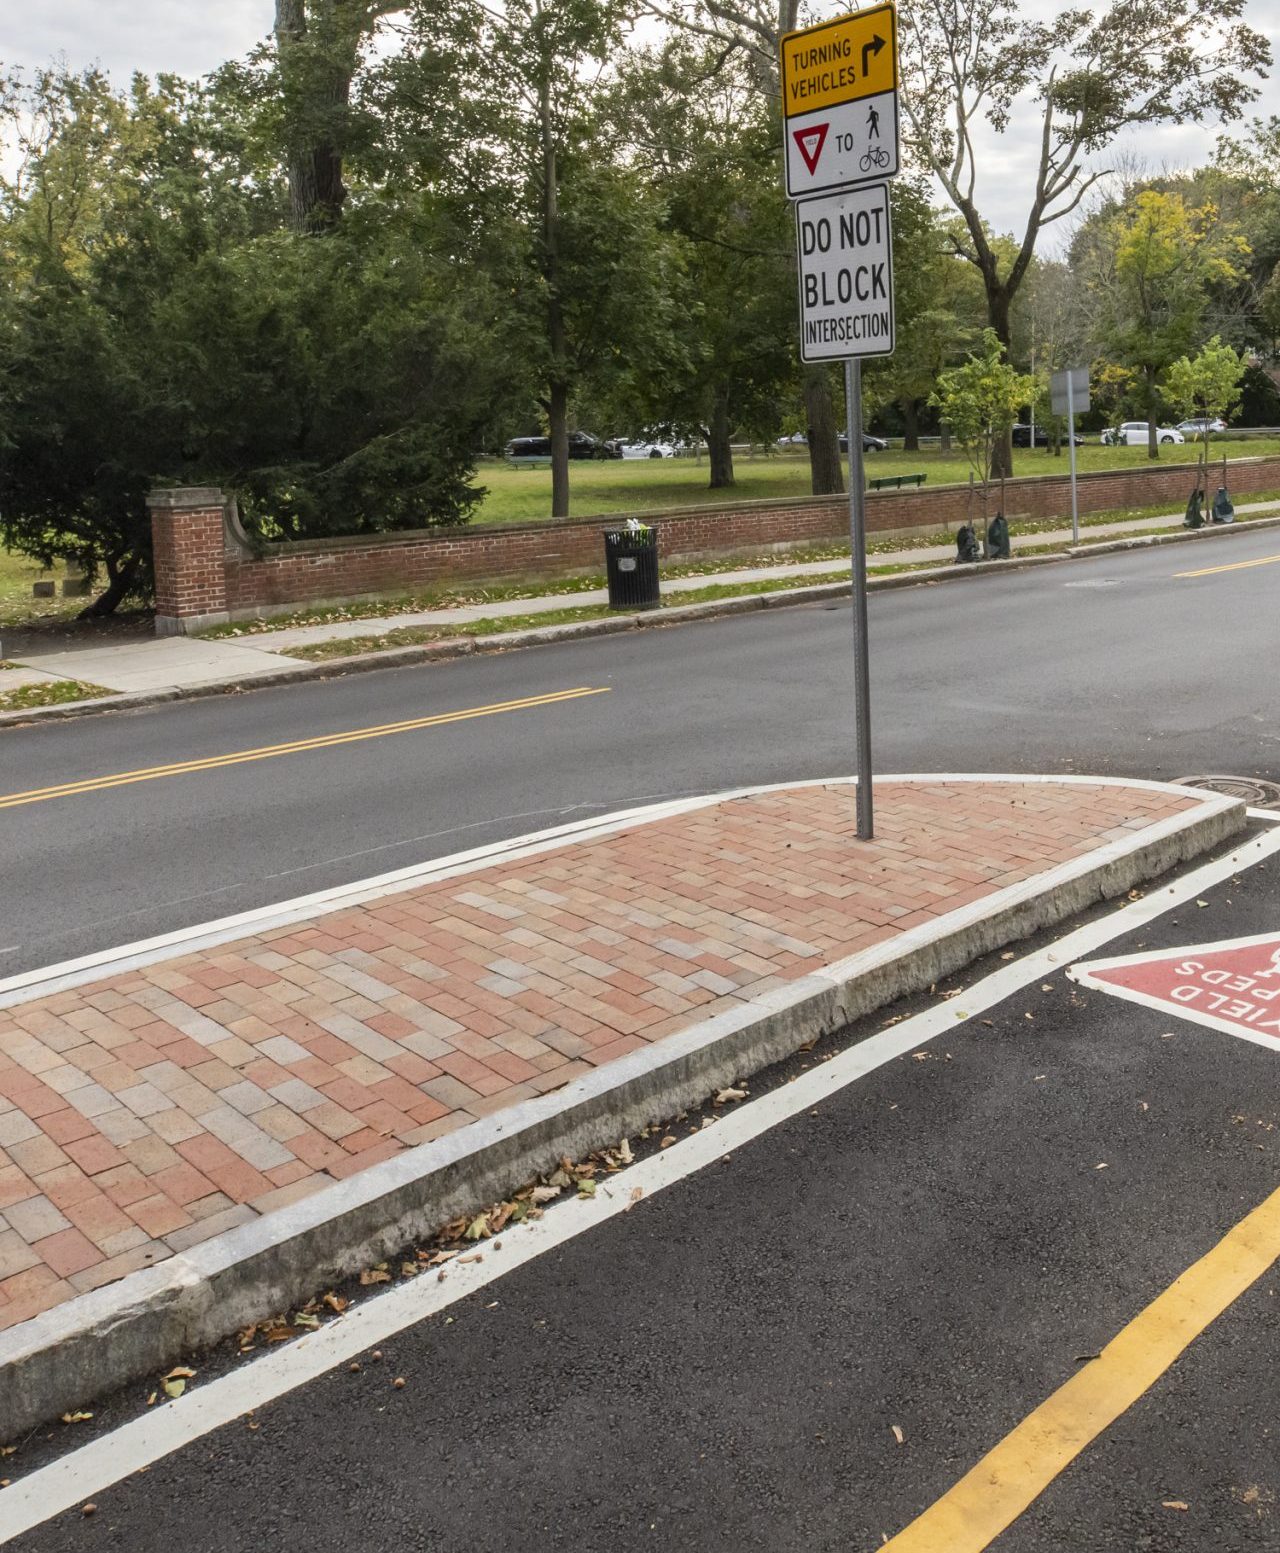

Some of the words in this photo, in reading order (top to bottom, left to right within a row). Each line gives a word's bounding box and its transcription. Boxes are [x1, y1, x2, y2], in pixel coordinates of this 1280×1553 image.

[793, 38, 851, 72] TURNING
[791, 66, 856, 99] VEHICLES
[836, 133, 853, 153] TO
[802, 218, 831, 256] DO
[840, 207, 883, 250] NOT
[804, 262, 886, 308] BLOCK
[806, 312, 888, 344] INTERSECTION
